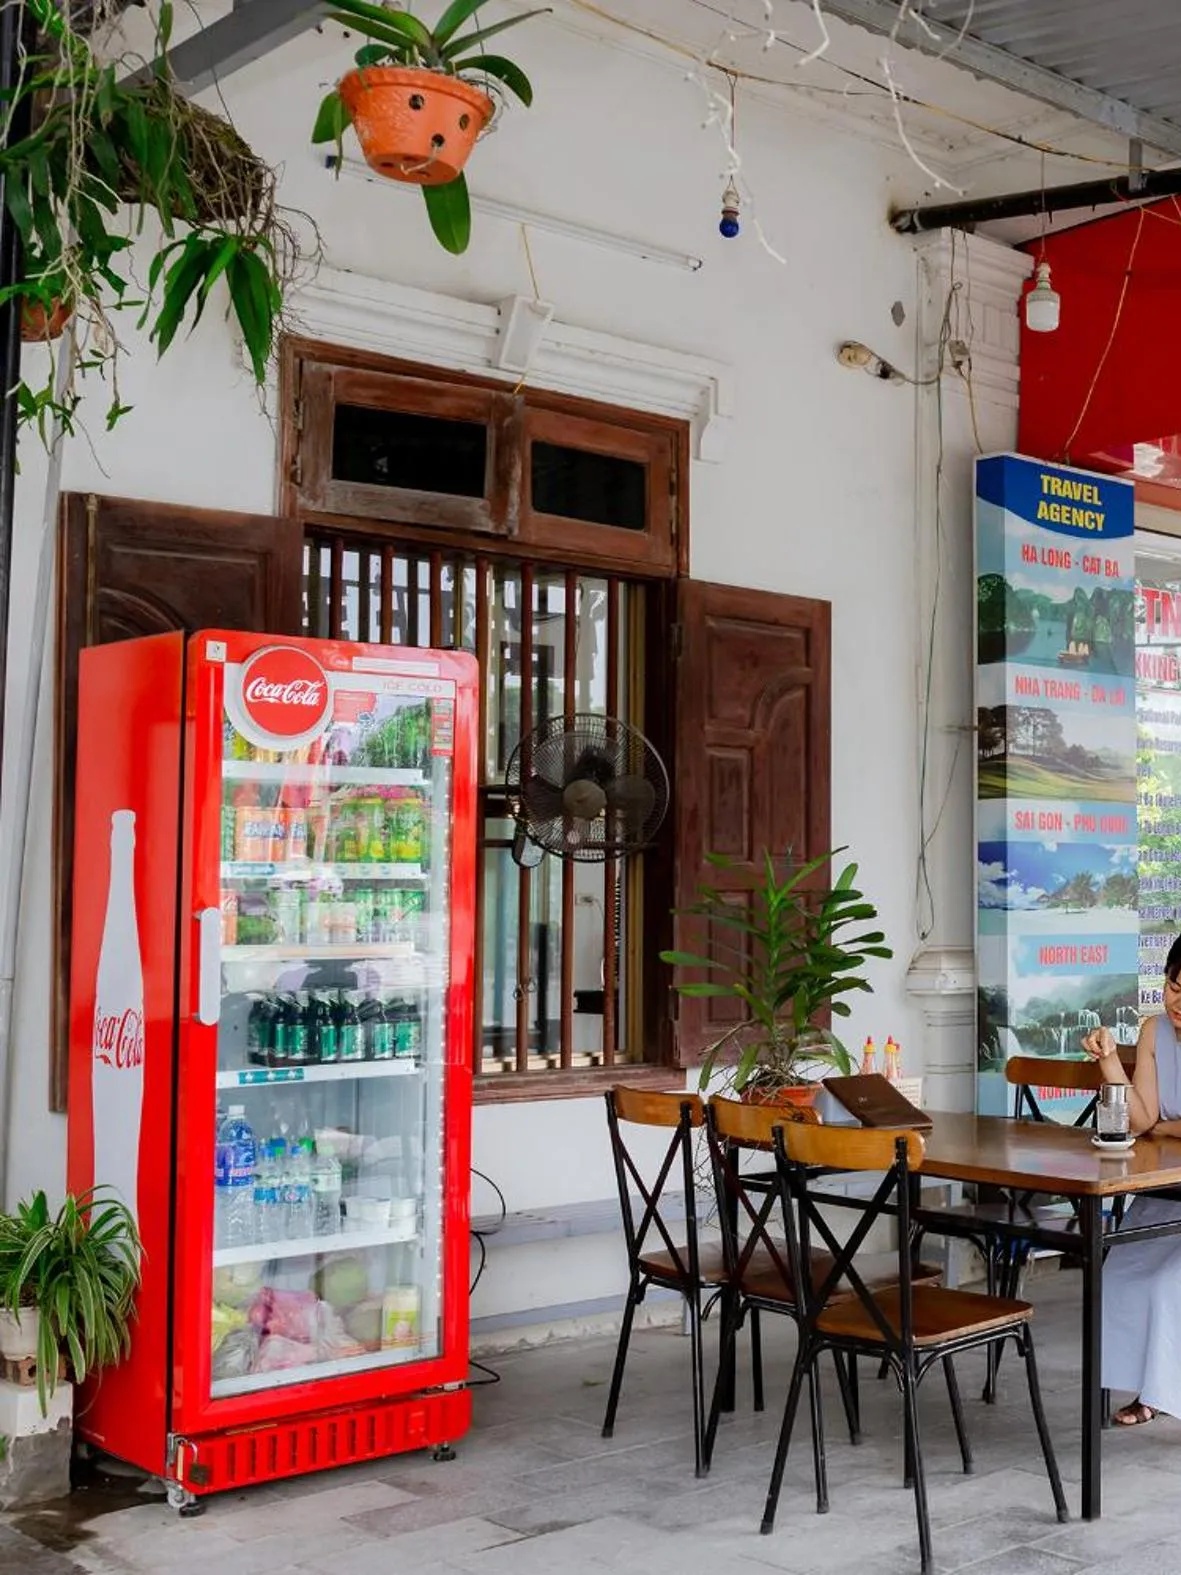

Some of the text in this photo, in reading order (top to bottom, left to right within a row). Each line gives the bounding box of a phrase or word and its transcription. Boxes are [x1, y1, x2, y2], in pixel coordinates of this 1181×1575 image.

[1040, 473, 1103, 506] TRAVEL
[1036, 499, 1106, 532] AGENCY
[1021, 543, 1038, 563] HA
[1041, 546, 1072, 569] LONG
[1082, 554, 1102, 575] CAT
[1104, 558, 1120, 578] BA
[246, 676, 325, 706] Coca-Cola
[1038, 811, 1063, 832] GON
[1038, 943, 1109, 966] NORTH EAST
